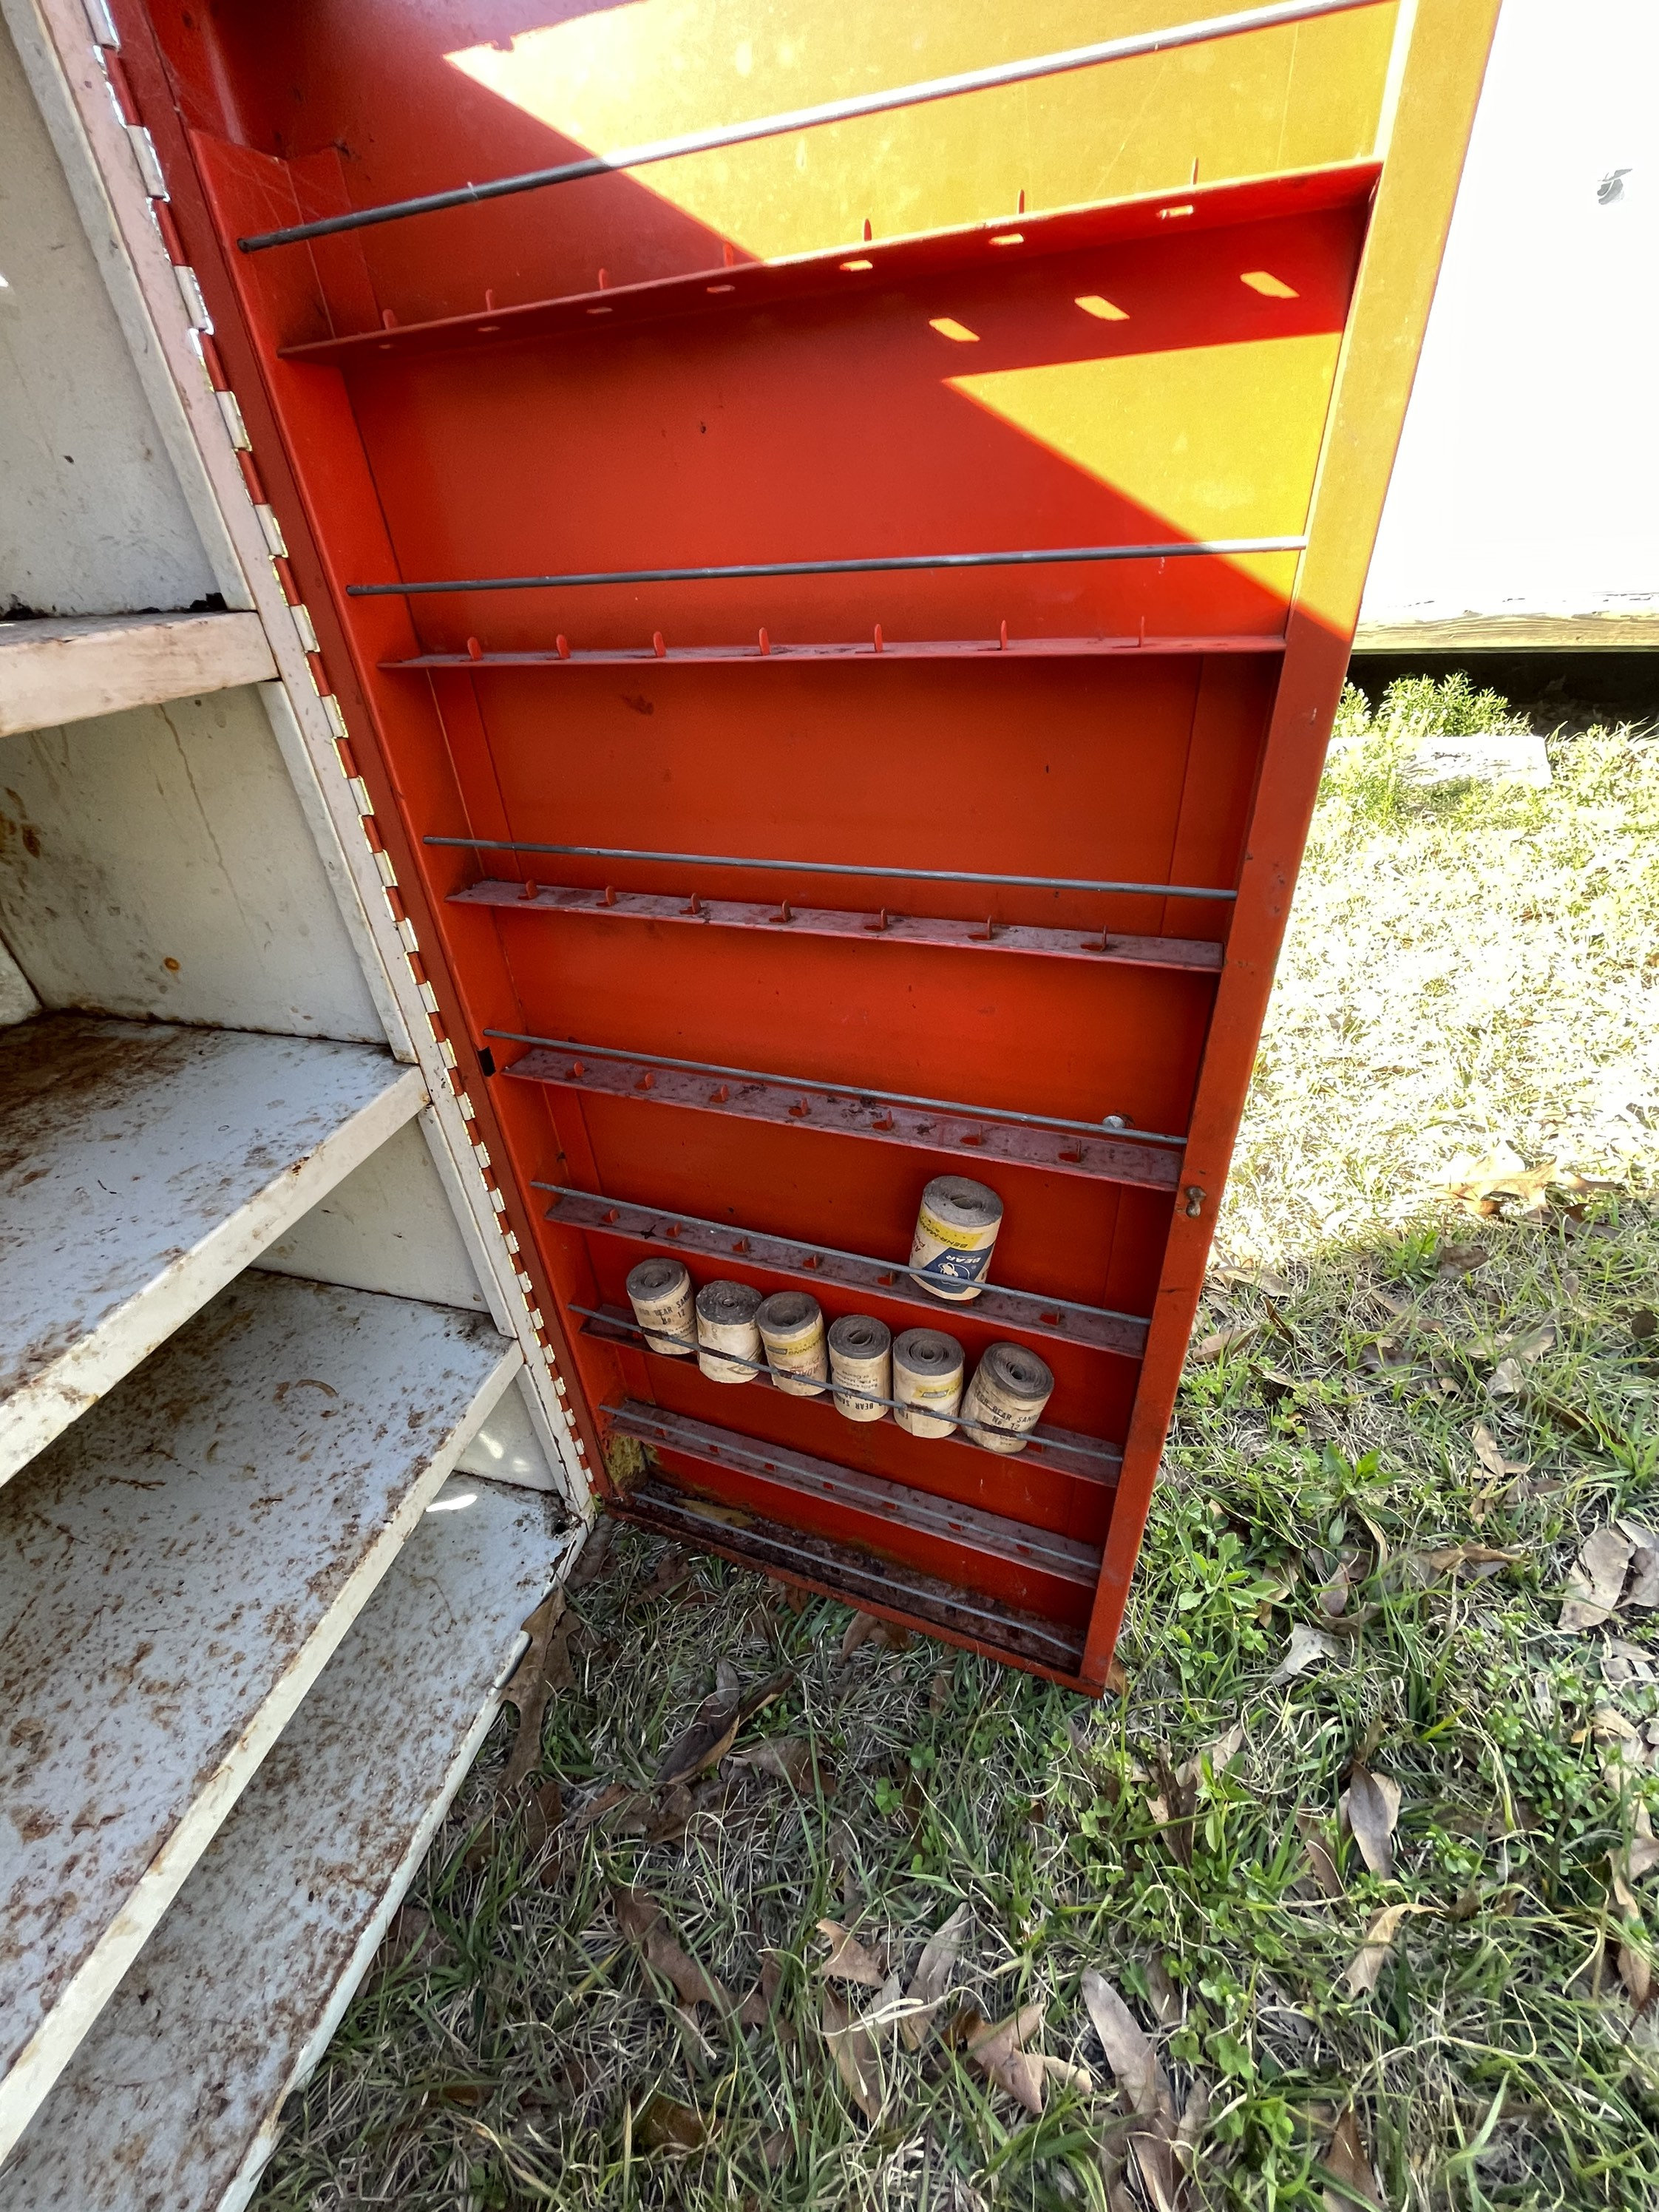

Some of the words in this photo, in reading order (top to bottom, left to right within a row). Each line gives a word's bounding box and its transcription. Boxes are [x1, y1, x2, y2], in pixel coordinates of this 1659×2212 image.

[946, 1255, 981, 1264] BEAR
[654, 1306, 673, 1317] BEAR
[678, 1309, 685, 1318] 12
[991, 1405, 1012, 1421] BEAR
[1011, 1422, 1020, 1431] 12
